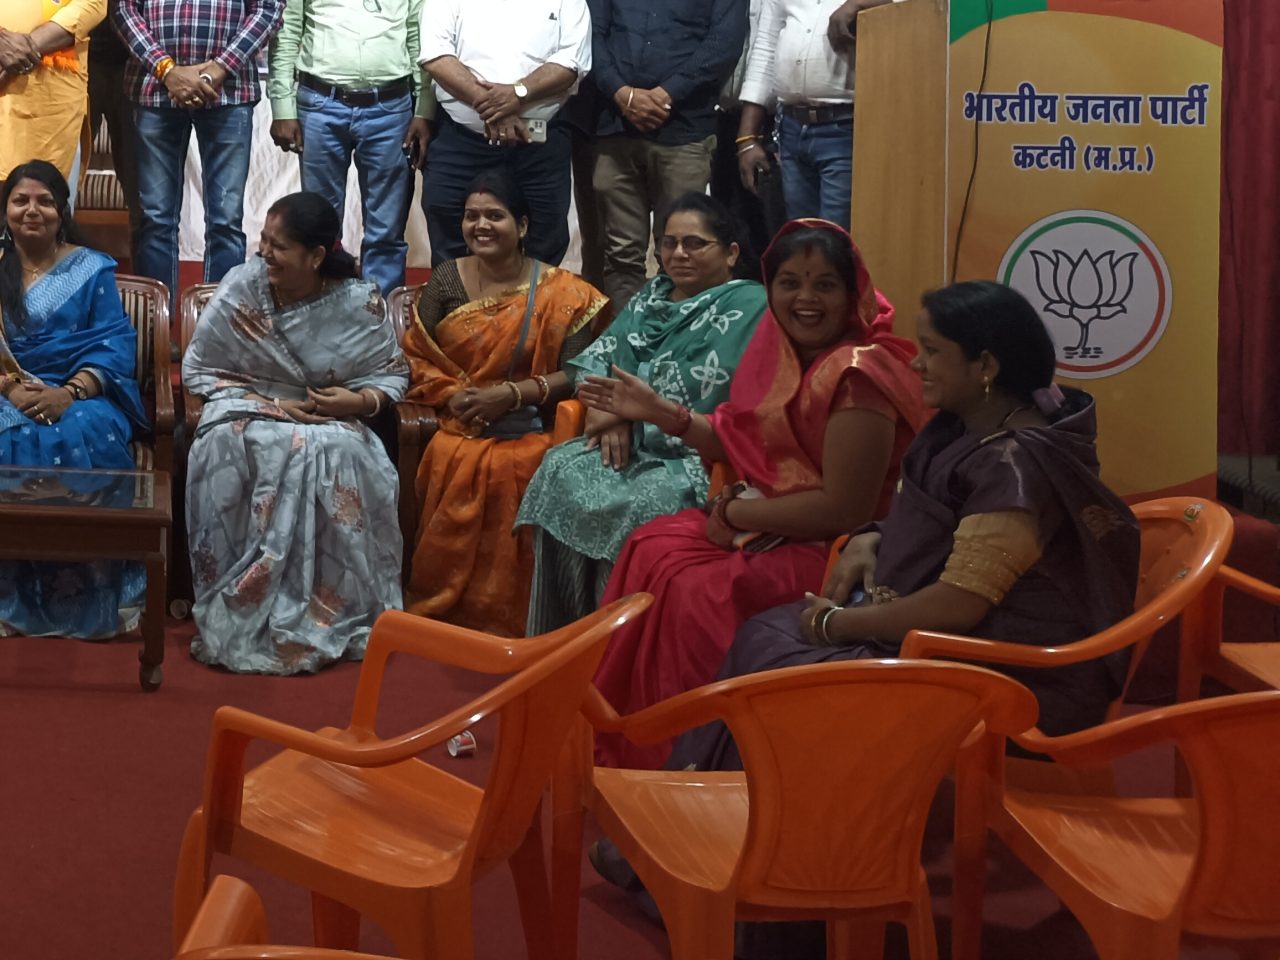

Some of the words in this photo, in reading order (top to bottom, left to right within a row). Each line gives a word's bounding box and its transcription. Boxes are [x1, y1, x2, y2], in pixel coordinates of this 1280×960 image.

[964, 82, 1058, 122] भारतीय
[1065, 95, 1142, 123] जनता
[1149, 84, 1209, 125] पार्टी
[1013, 136, 1076, 170] कटनी
[1084, 145, 1153, 171] (म.प्र.)
